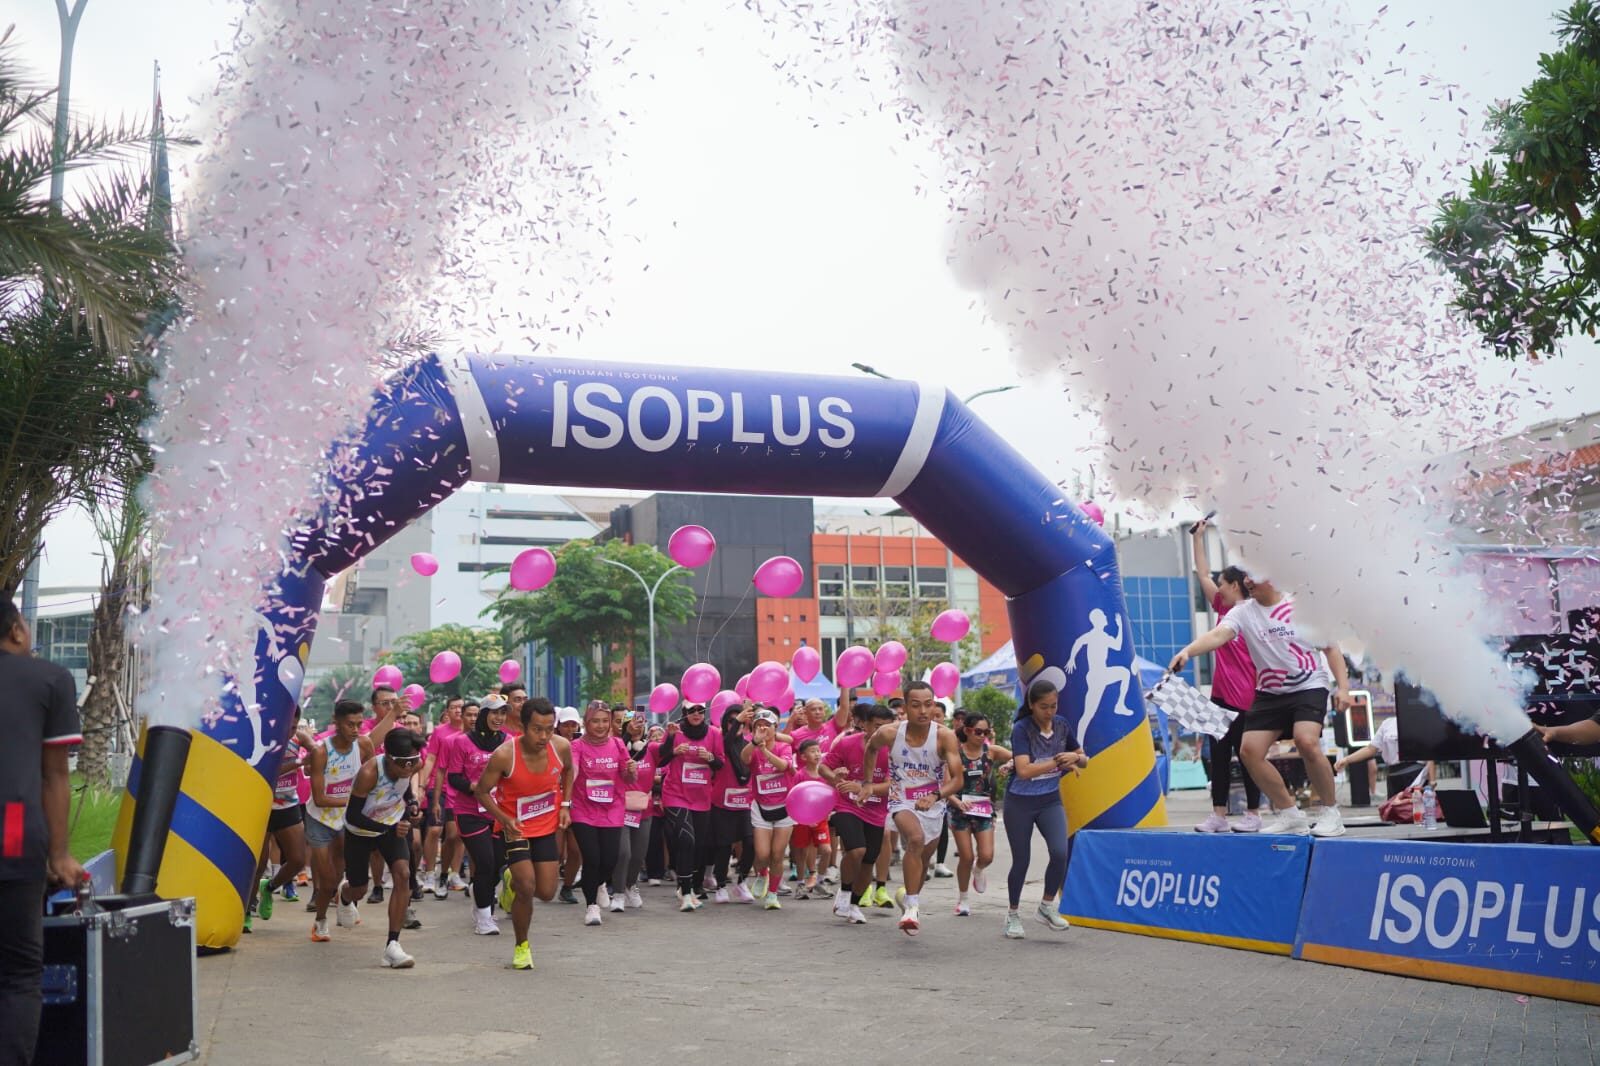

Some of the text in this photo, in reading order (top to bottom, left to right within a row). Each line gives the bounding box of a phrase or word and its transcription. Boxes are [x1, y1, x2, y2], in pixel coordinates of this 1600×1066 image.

[552, 367, 679, 382] MINUMAN ISOTONIK
[552, 380, 855, 452] ISOPLUS
[1384, 854, 1475, 868] MINUMAN ISOTONIK
[1116, 869, 1220, 908] ISOPLUS
